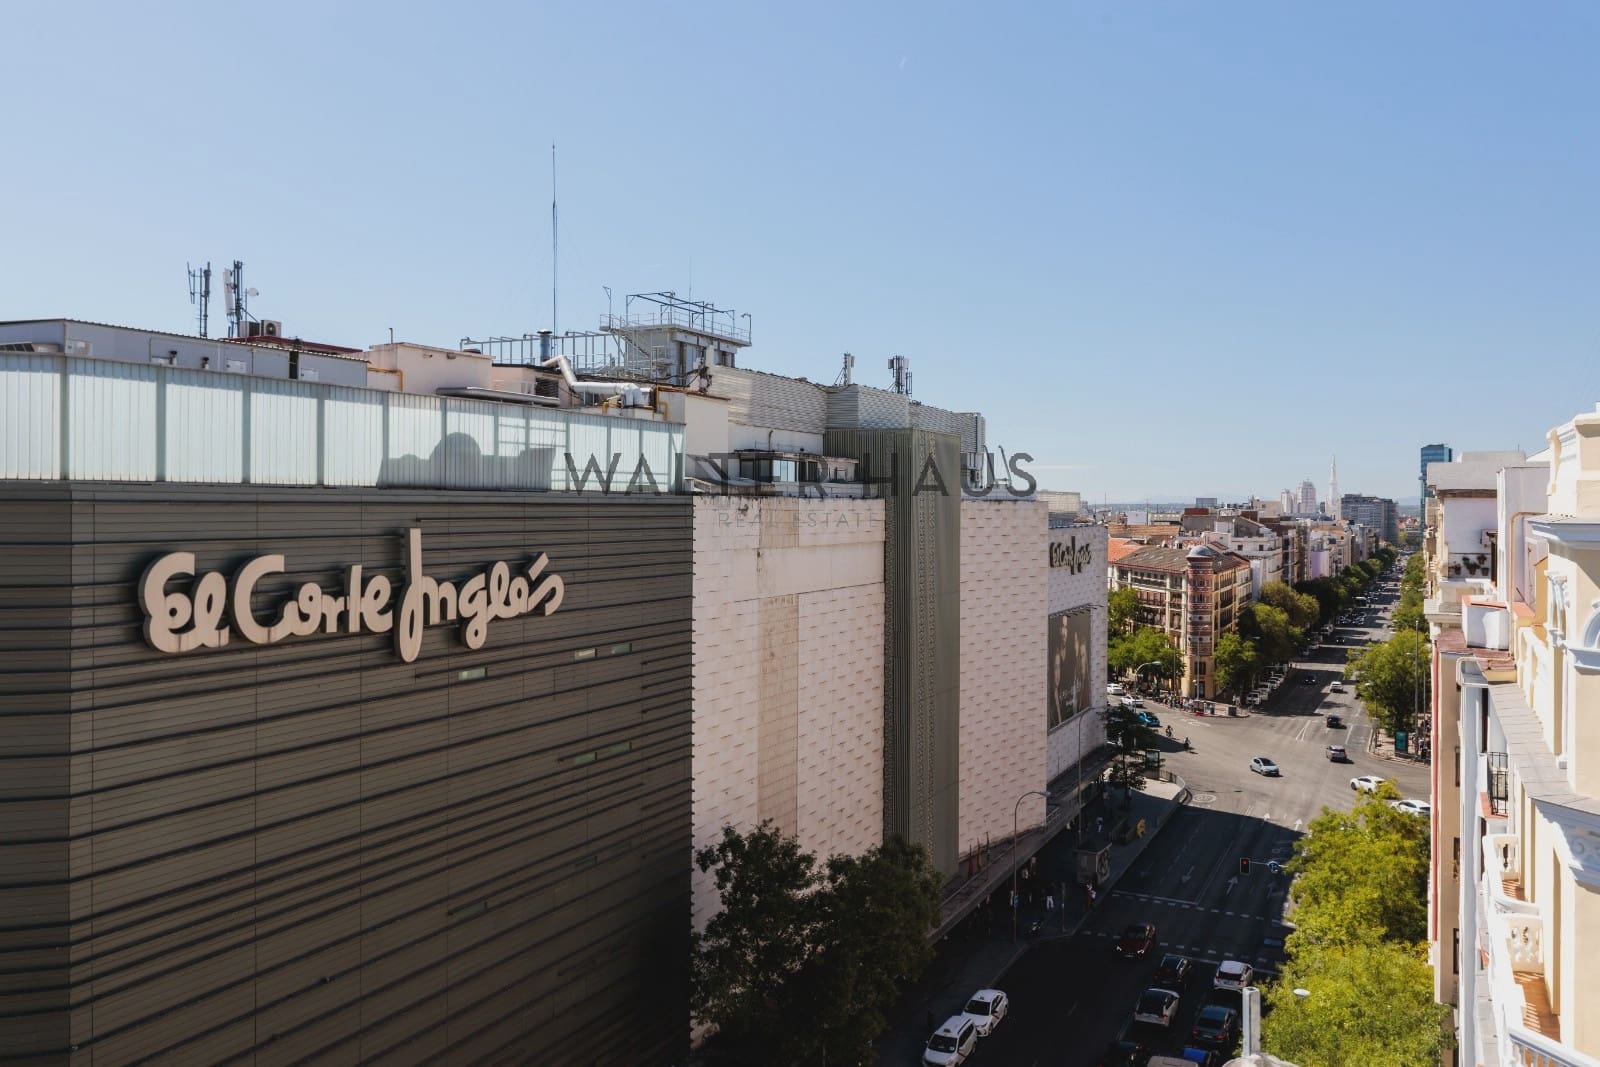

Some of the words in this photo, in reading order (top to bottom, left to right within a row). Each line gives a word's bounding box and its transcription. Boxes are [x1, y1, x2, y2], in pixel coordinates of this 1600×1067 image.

[139, 551, 229, 653] El
[232, 553, 393, 645] Corte
[395, 527, 565, 663] Inglés
